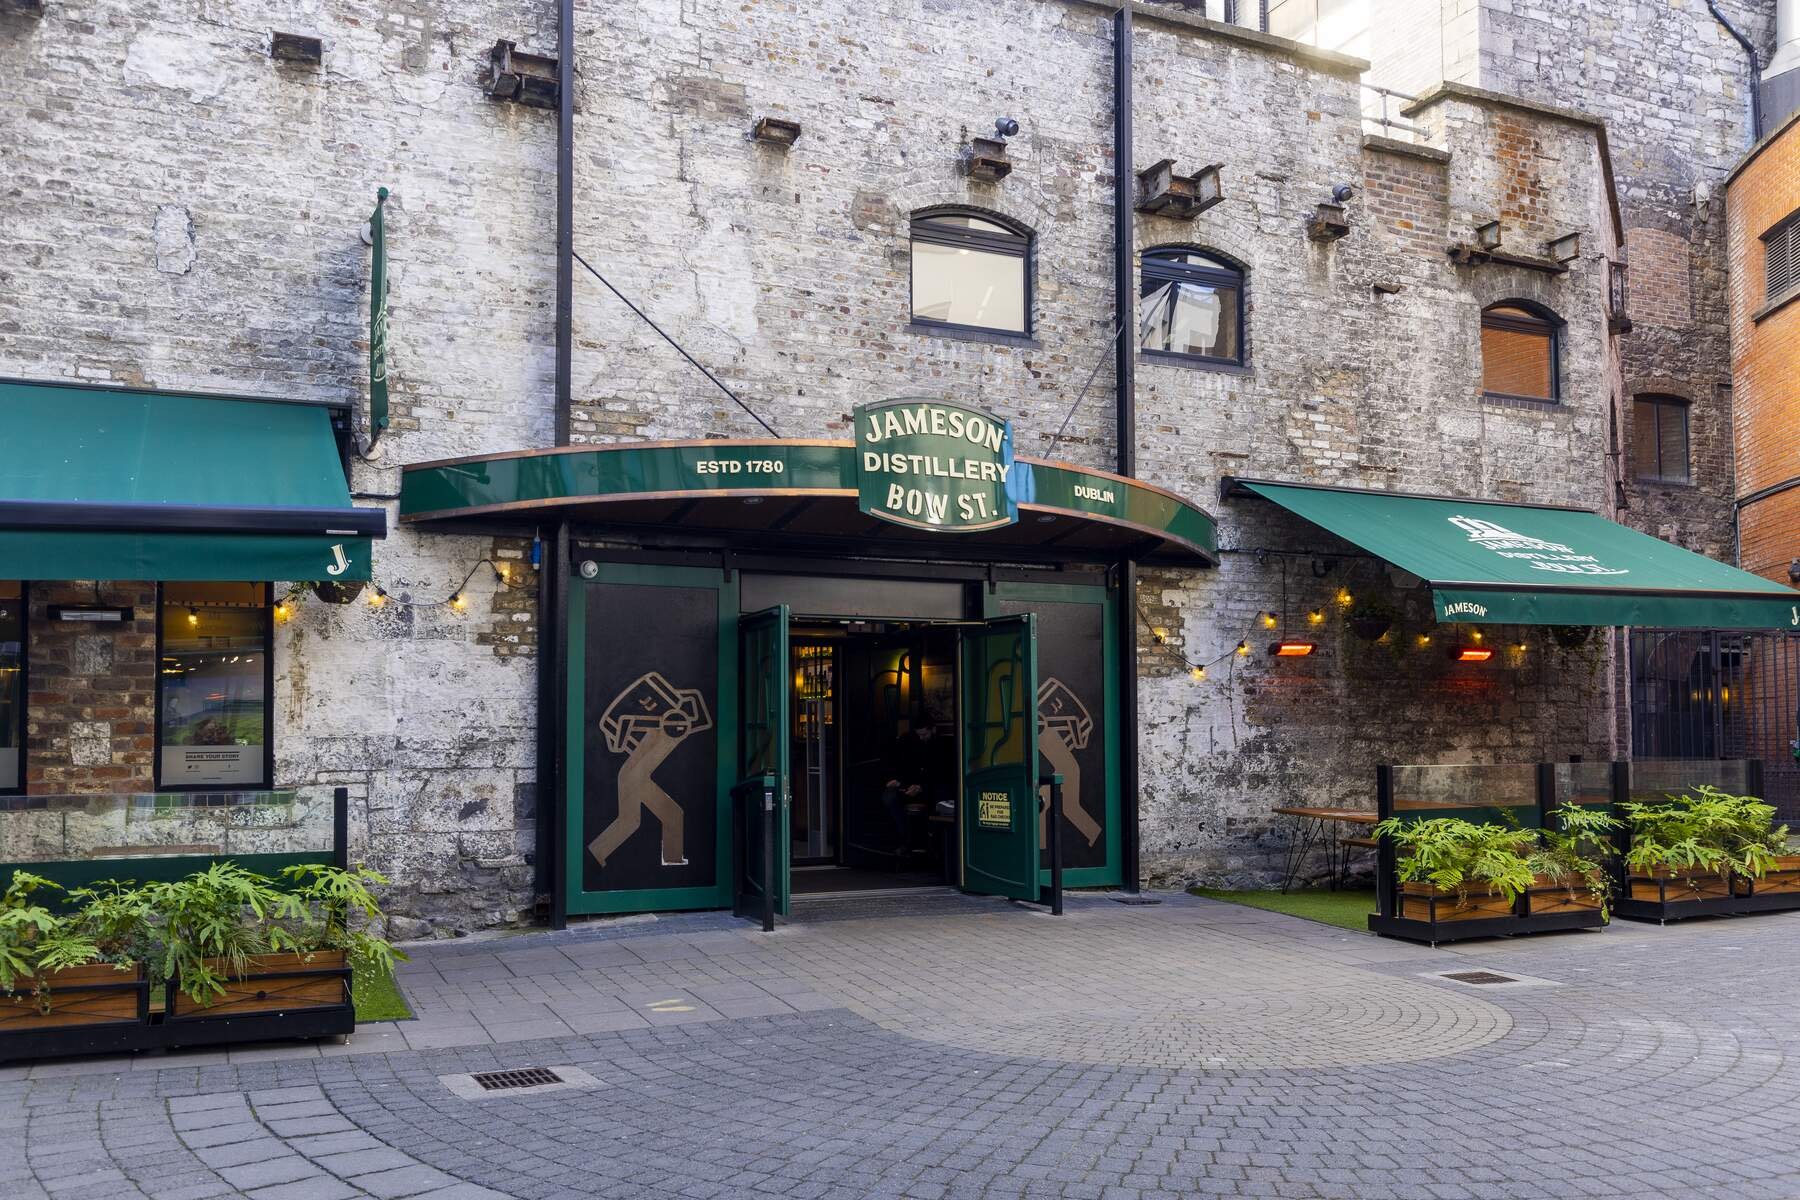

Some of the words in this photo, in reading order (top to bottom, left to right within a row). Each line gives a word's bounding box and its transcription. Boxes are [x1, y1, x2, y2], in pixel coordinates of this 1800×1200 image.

[865, 408, 1004, 453] JAMESON
[696, 460, 742, 474] ESTD
[745, 460, 784, 474] 1780
[863, 452, 1010, 483] DISTILLERY
[886, 483, 948, 519] BOW
[957, 493, 998, 520] ST.
[1074, 485, 1114, 504] DUBLIN
[1444, 602, 1488, 617] JAMESON
[982, 792, 1008, 801] NOTICE
